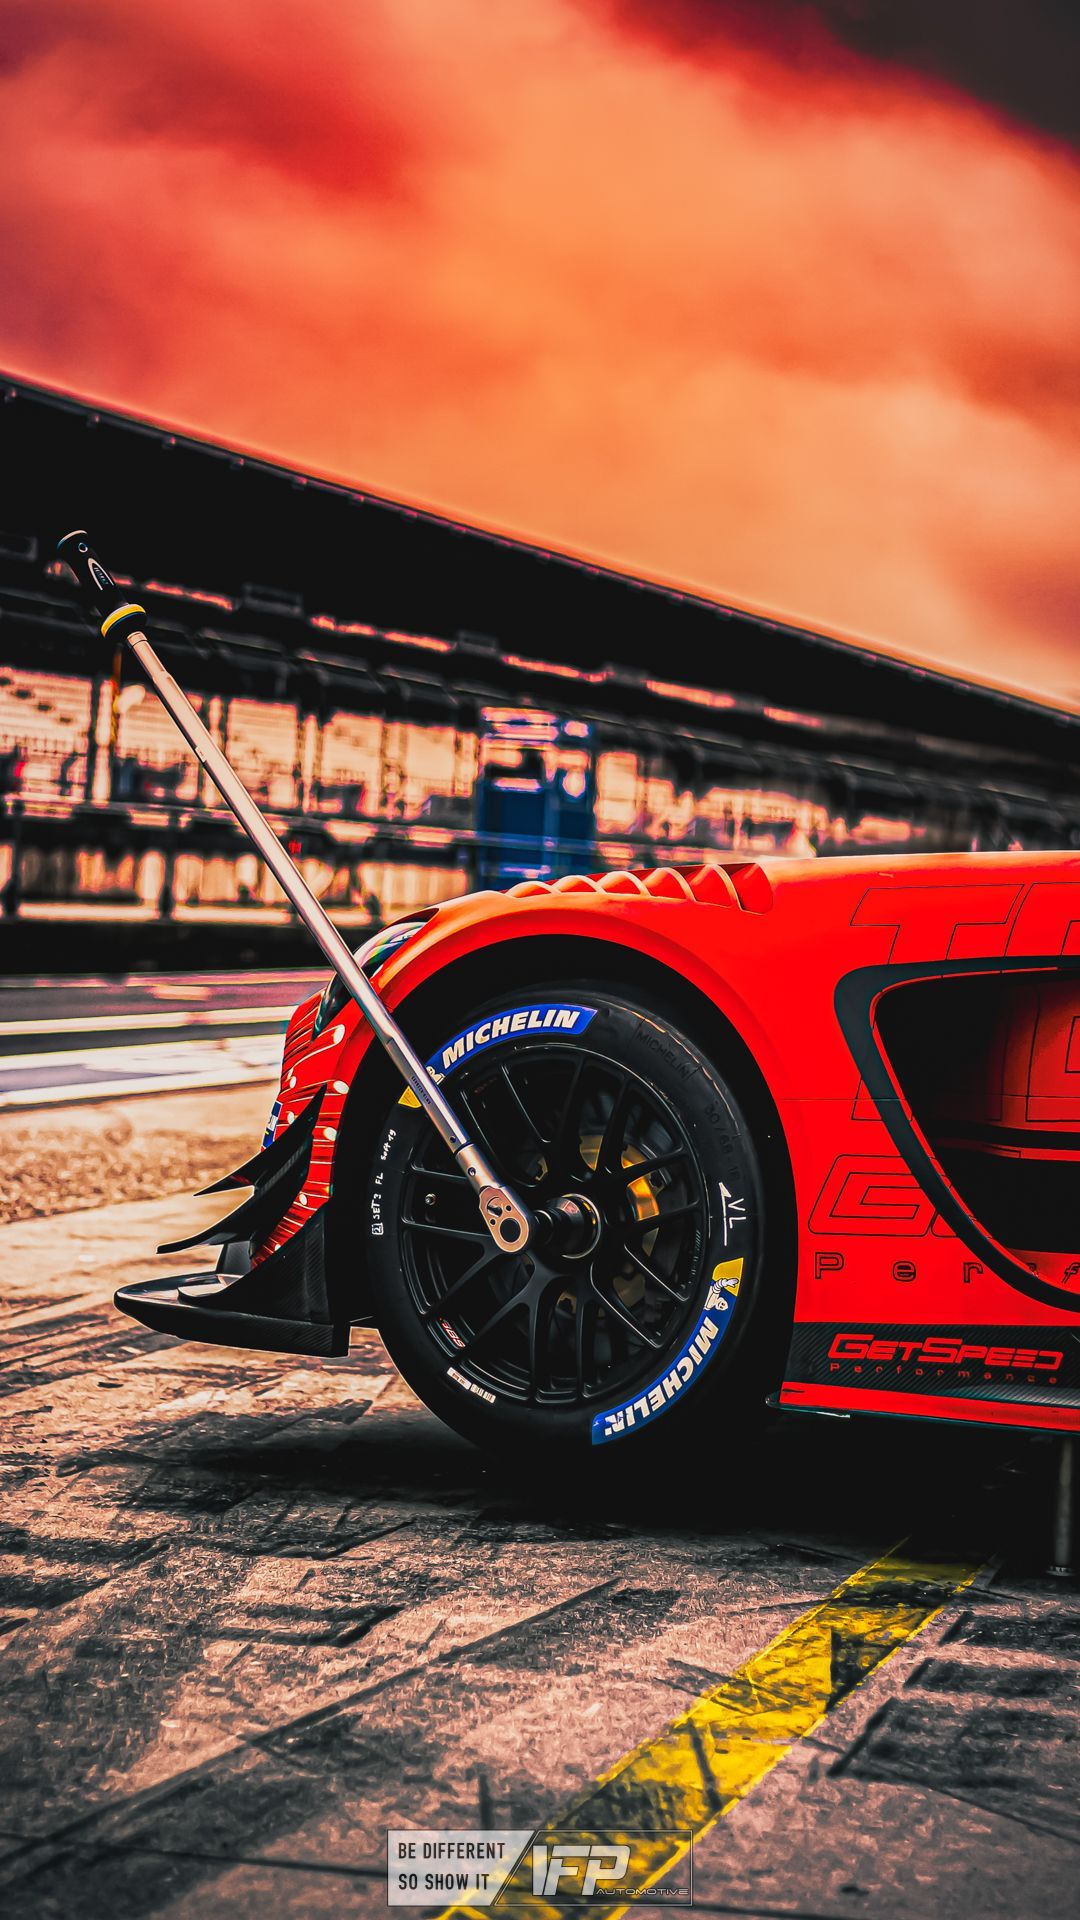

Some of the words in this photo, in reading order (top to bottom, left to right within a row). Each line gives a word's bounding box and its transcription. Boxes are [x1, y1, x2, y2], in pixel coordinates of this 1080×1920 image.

[442, 1009, 580, 1069] MICHELIN
[636, 1030, 689, 1078] MICHELIN
[375, 1172, 384, 1185] FL
[371, 1199, 381, 1220] SET
[727, 1197, 747, 1229] VL
[604, 1316, 719, 1436] MICHELIN
[829, 1362, 1057, 1385] Performance
